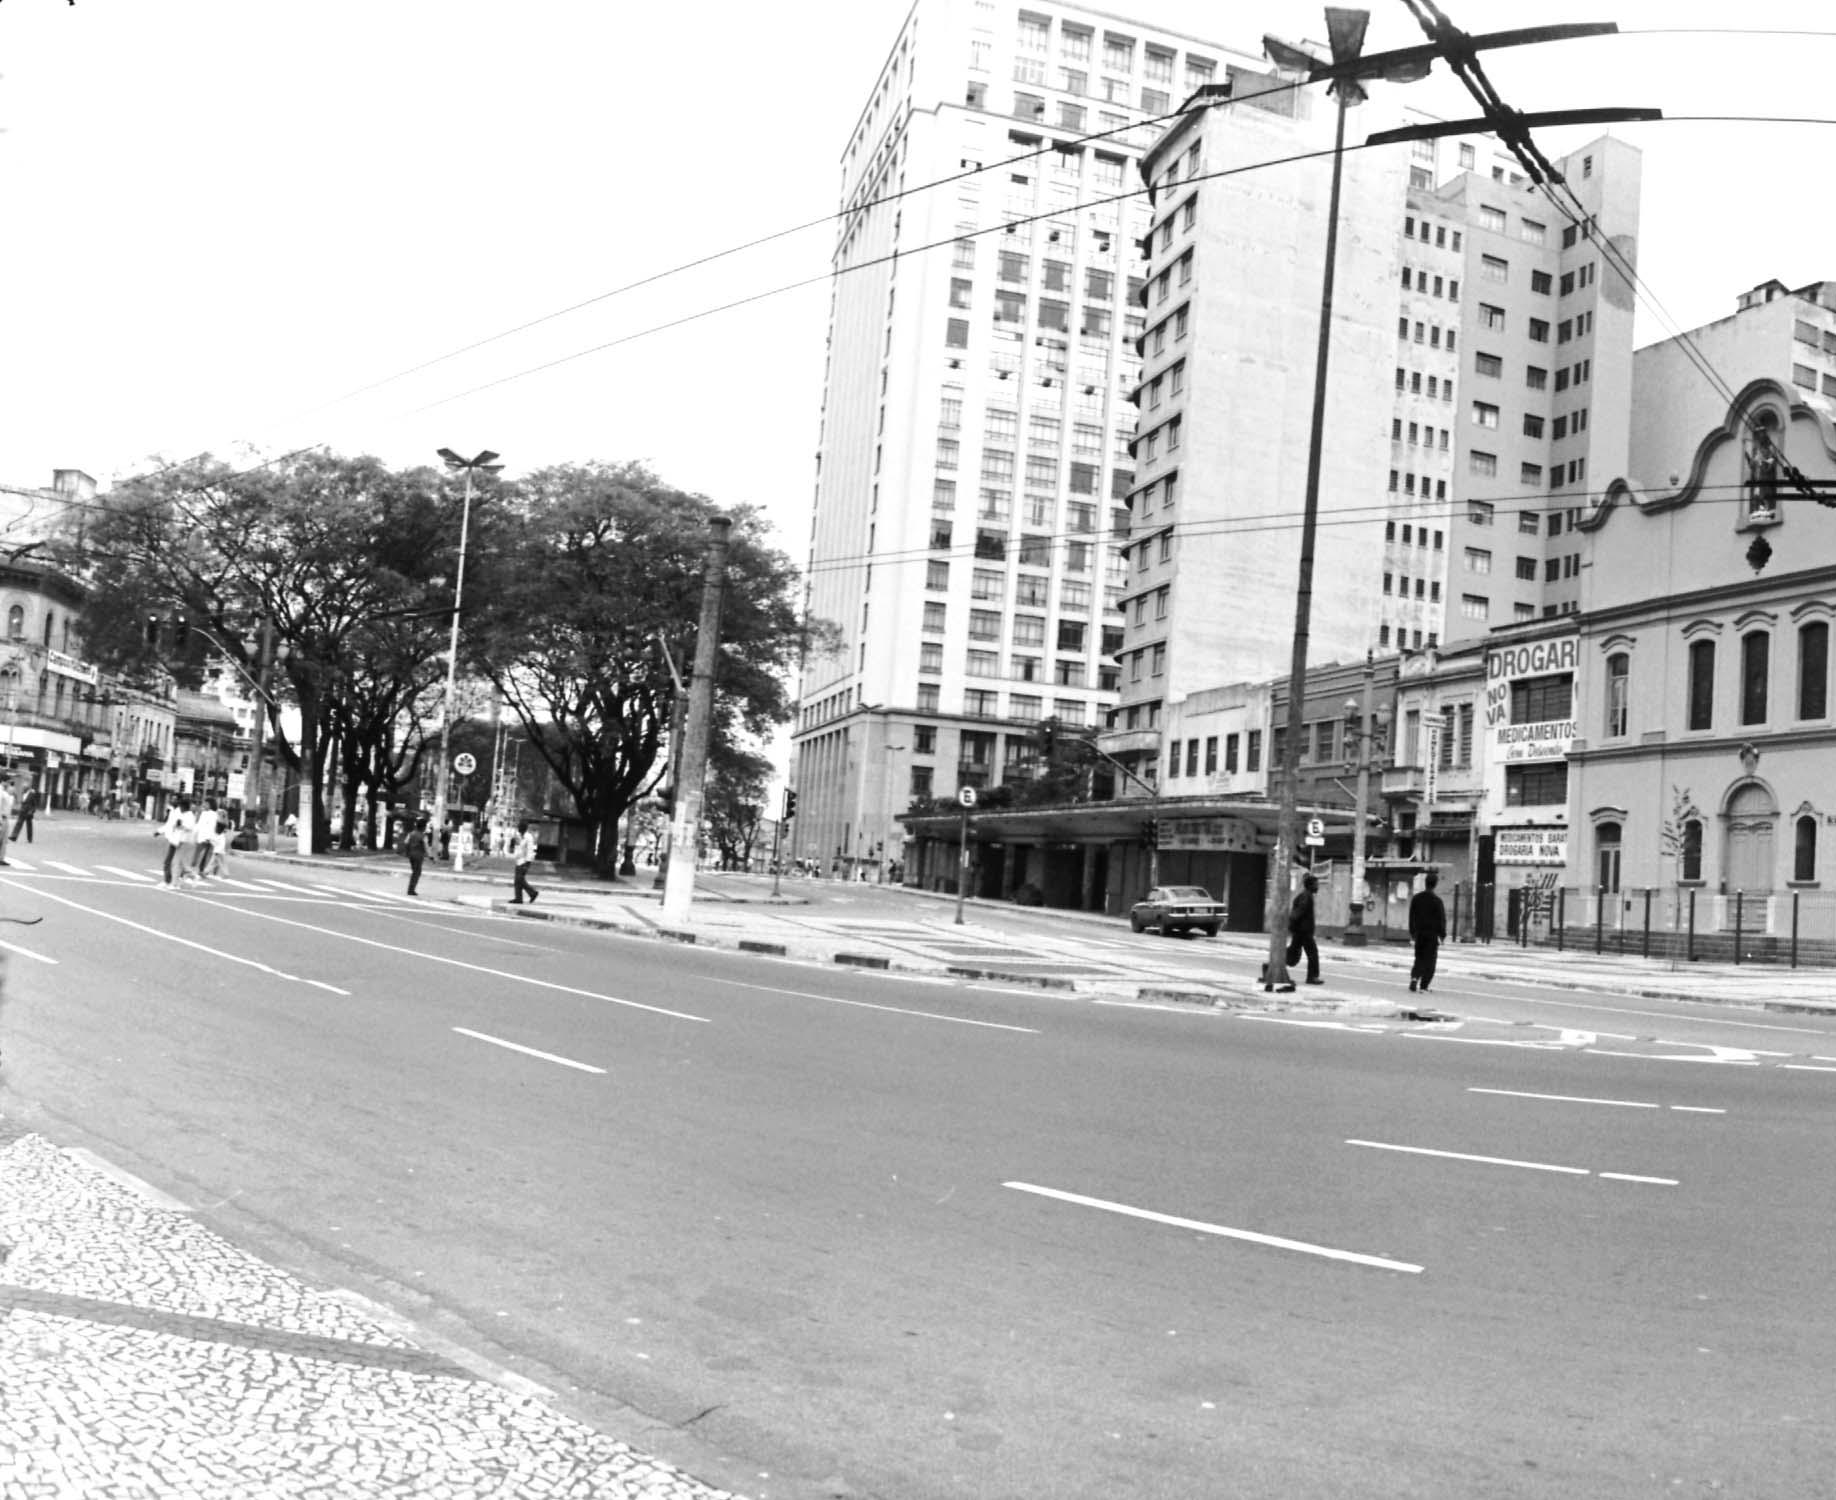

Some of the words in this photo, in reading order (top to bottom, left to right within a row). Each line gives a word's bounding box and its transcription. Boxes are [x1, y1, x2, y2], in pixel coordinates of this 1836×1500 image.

[1487, 683, 1507, 707] NO
[1486, 706, 1506, 726] VA
[963, 789, 973, 804] E
